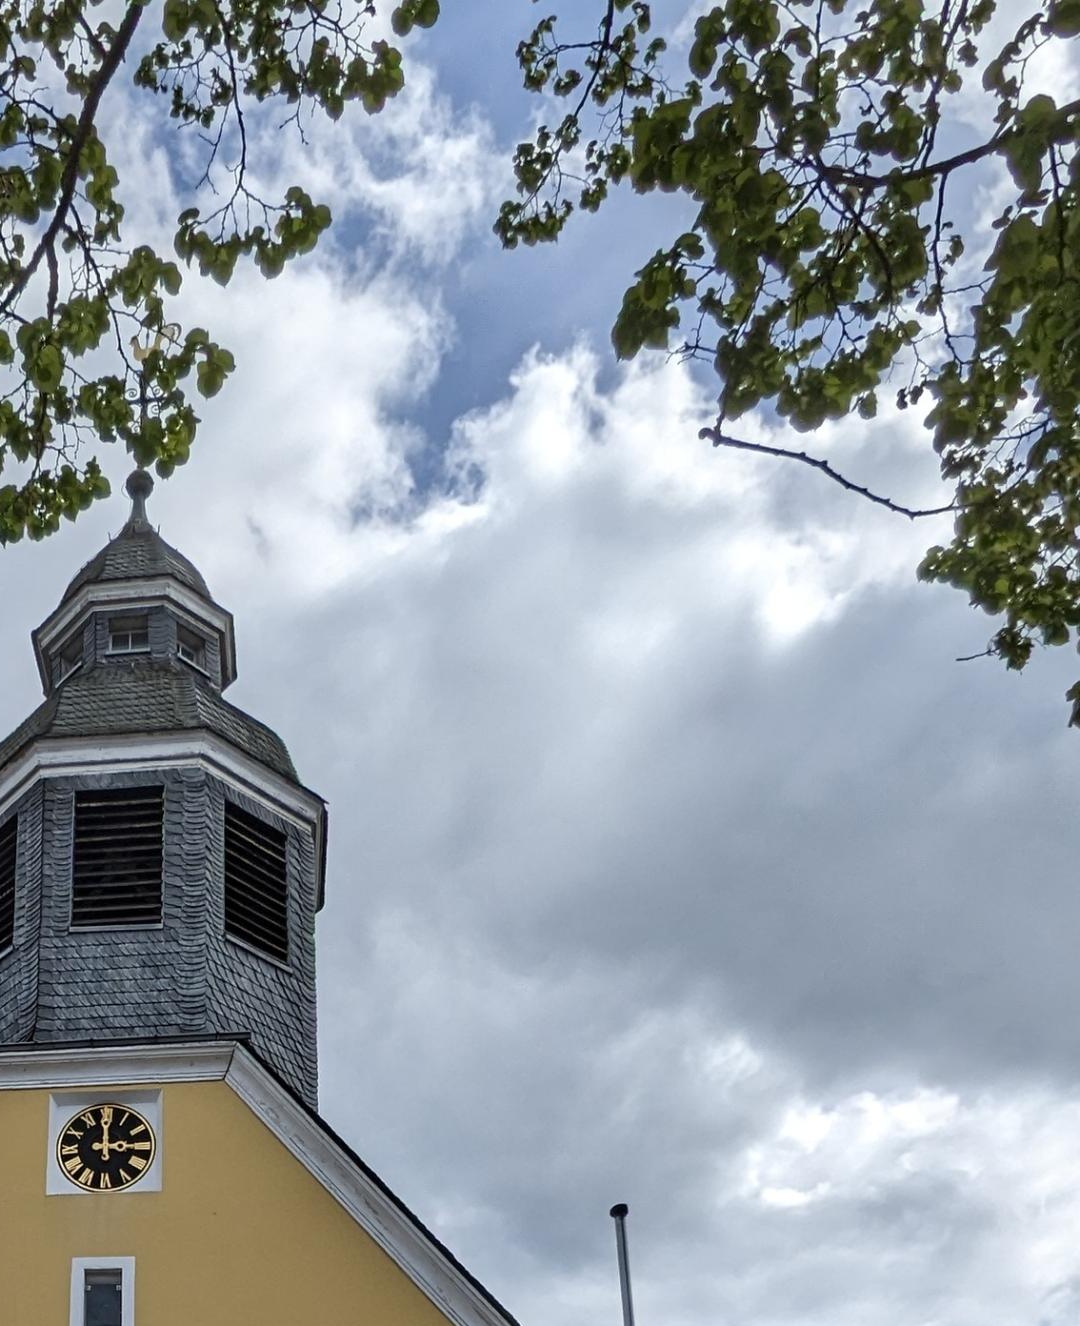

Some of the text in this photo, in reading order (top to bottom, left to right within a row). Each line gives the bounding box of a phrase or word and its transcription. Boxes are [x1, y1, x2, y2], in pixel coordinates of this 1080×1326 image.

[80, 1112, 96, 1129] XI
[66, 1127, 84, 1139] X
[129, 1124, 146, 1136] II
[61, 1144, 78, 1155] IX
[78, 1167, 95, 1186] VII
[100, 1172, 111, 1188] VI
[119, 1168, 131, 1183] V
